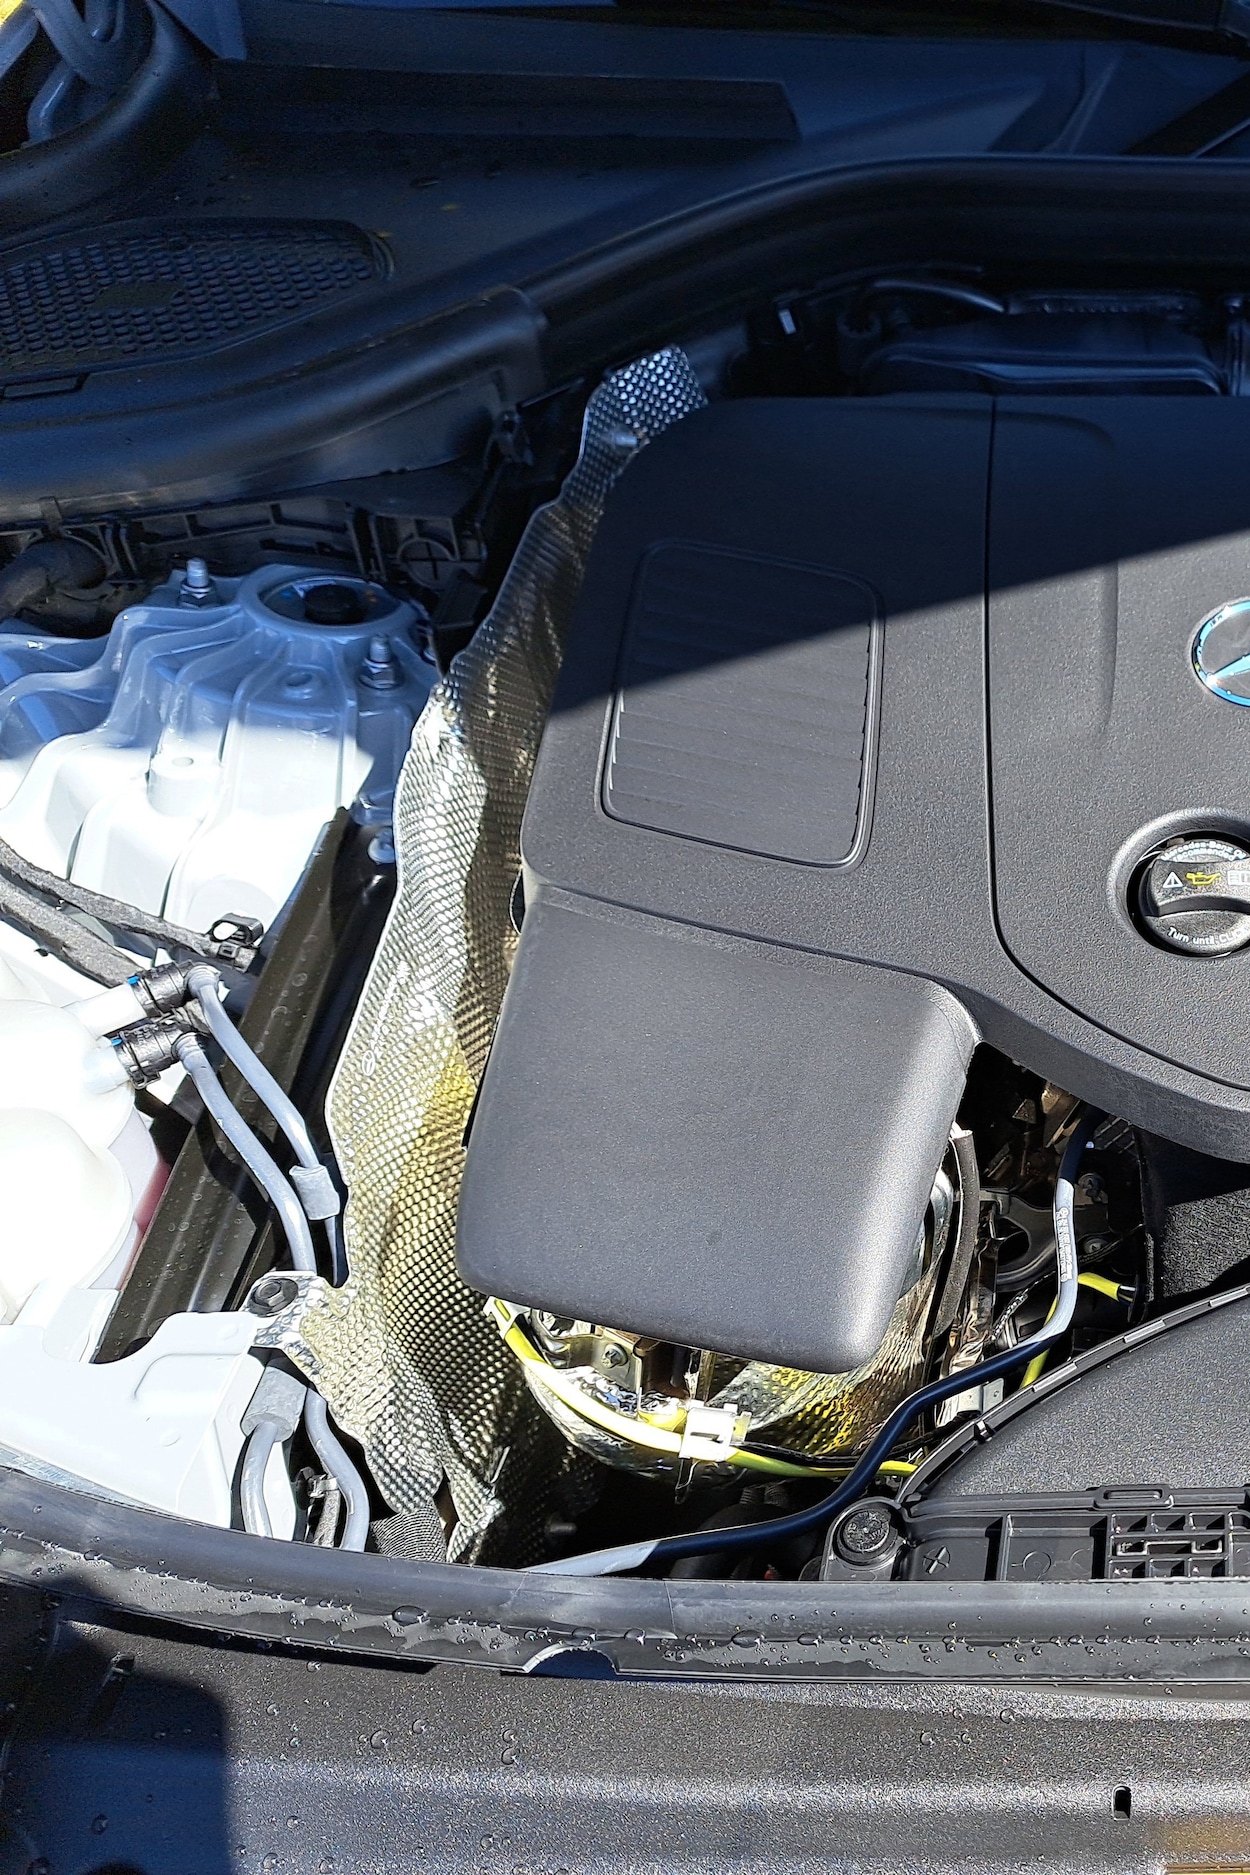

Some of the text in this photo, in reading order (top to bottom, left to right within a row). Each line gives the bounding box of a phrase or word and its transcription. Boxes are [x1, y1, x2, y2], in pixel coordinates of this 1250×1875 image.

[1160, 840, 1234, 861] Mercedes-Benz
[1167, 926, 1190, 943] Turn
[1192, 935, 1215, 945] until
